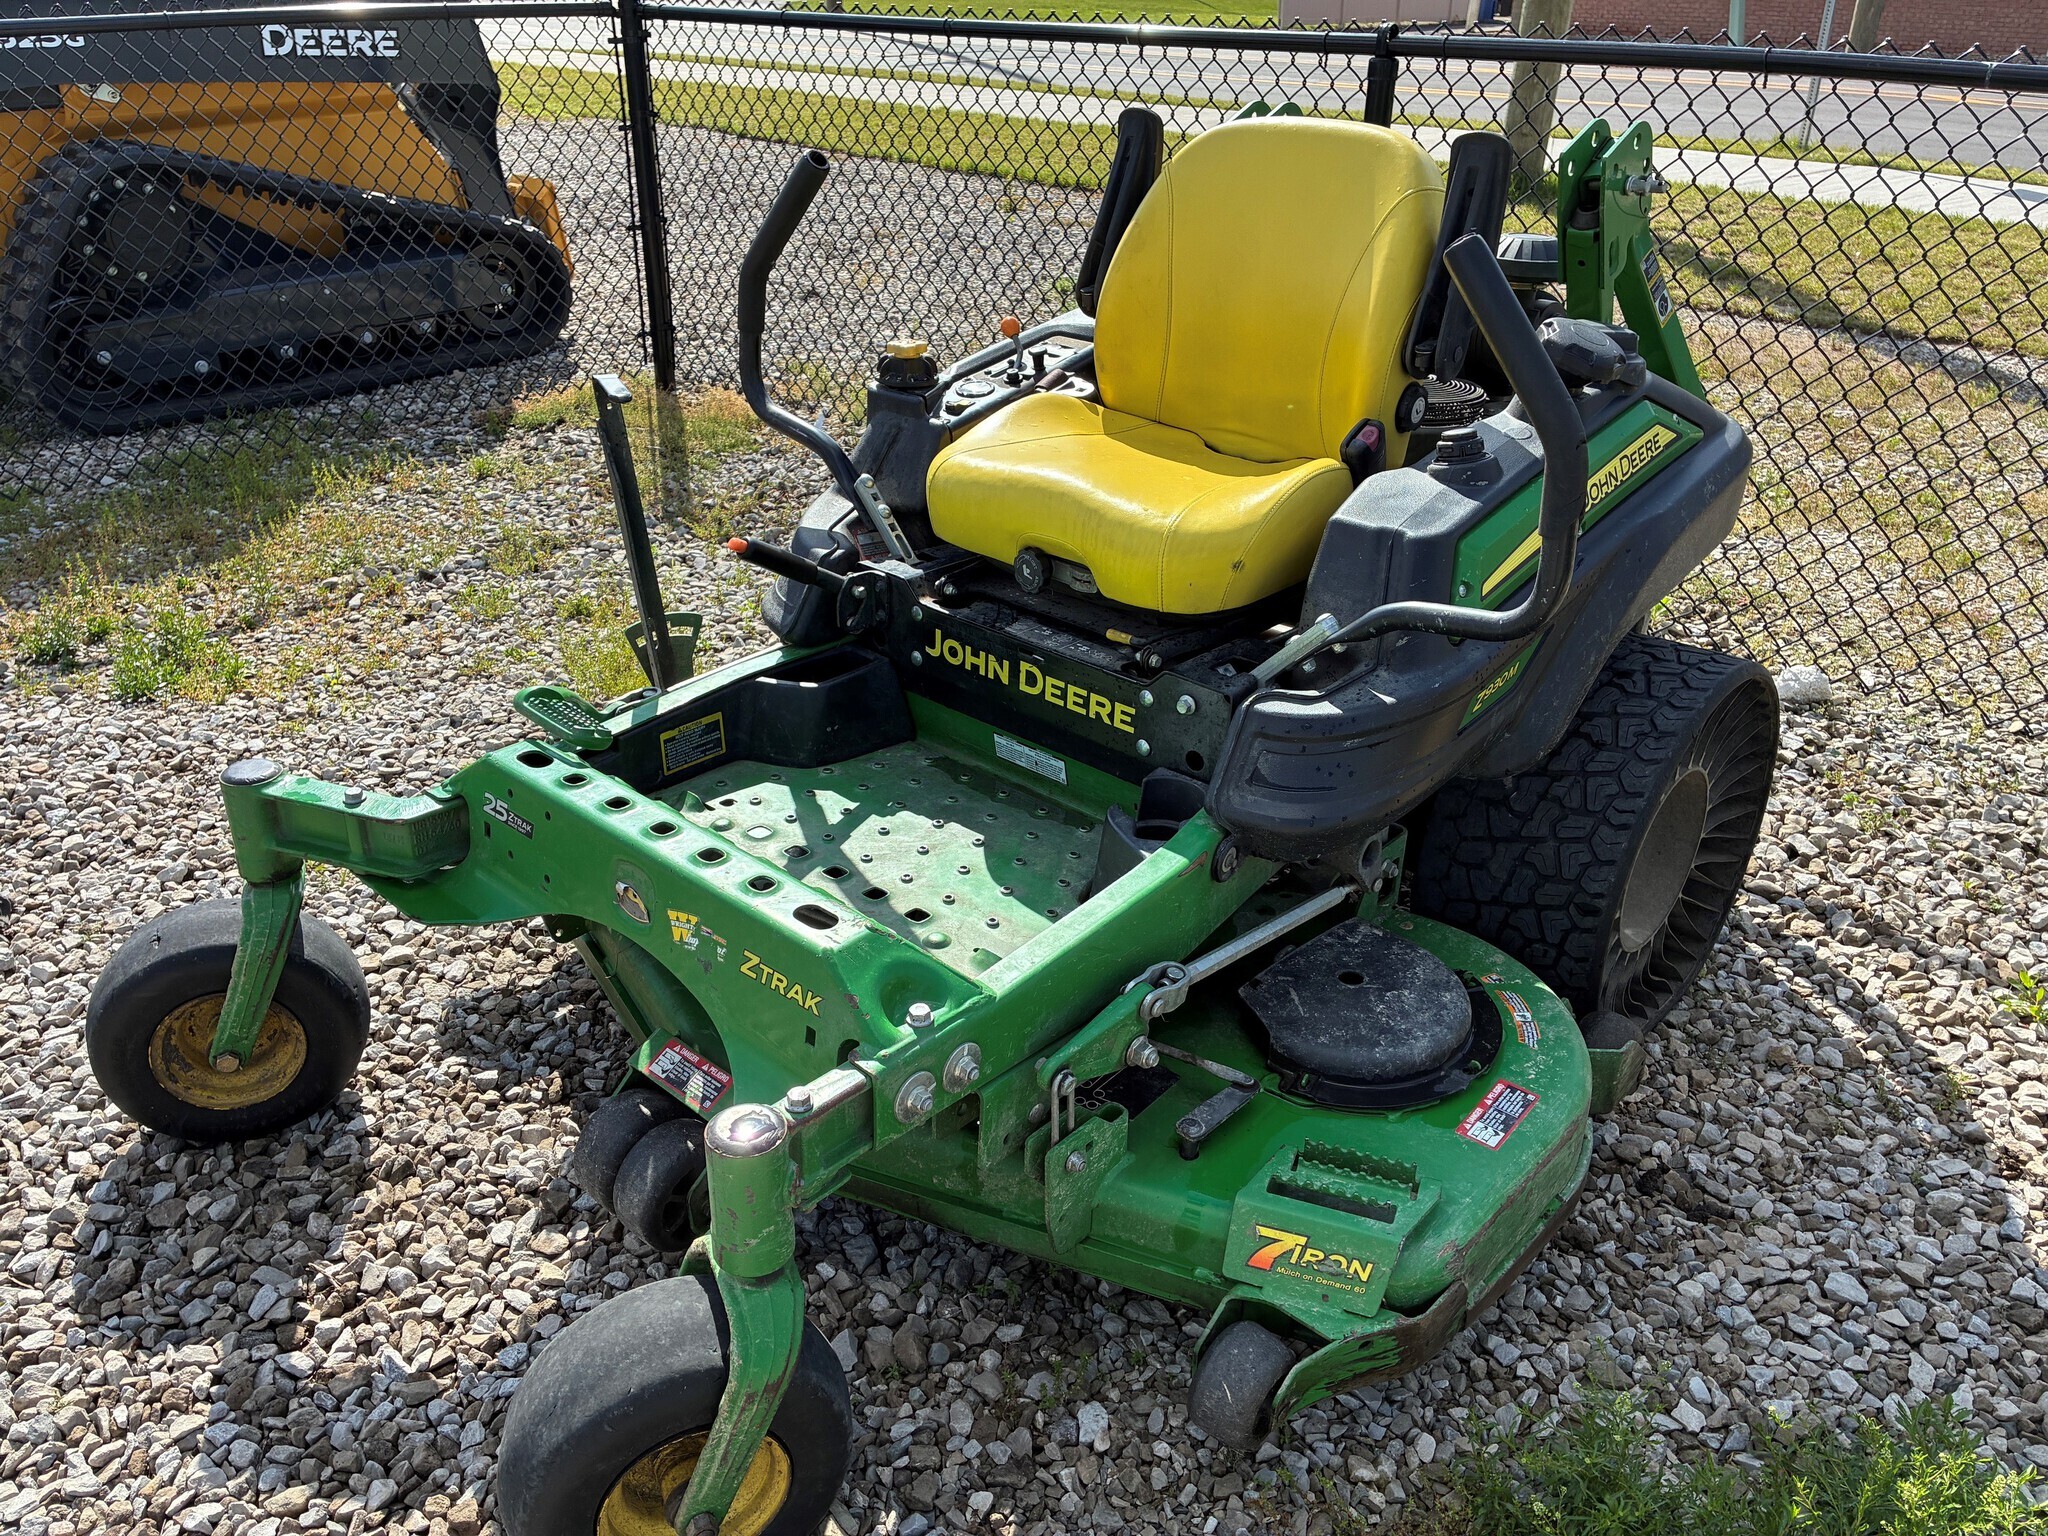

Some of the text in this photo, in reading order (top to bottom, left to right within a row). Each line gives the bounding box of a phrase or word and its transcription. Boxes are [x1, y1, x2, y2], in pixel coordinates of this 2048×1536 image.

[260, 24, 400, 57] DEERE
[1619, 432, 1661, 478] DEERE
[925, 628, 1010, 686] JOHN
[1019, 660, 1136, 734] DEERE
[483, 791, 508, 822] 25
[508, 811, 532, 833] ZTRAK
[739, 949, 823, 1017] ZTRAK
[680, 1047, 700, 1063] DANGER
[708, 1066, 730, 1083] PELIGRO
[1276, 1266, 1301, 1279] Mulch
[1315, 1276, 1351, 1291] Demand
[1354, 1286, 1366, 1294] 60
